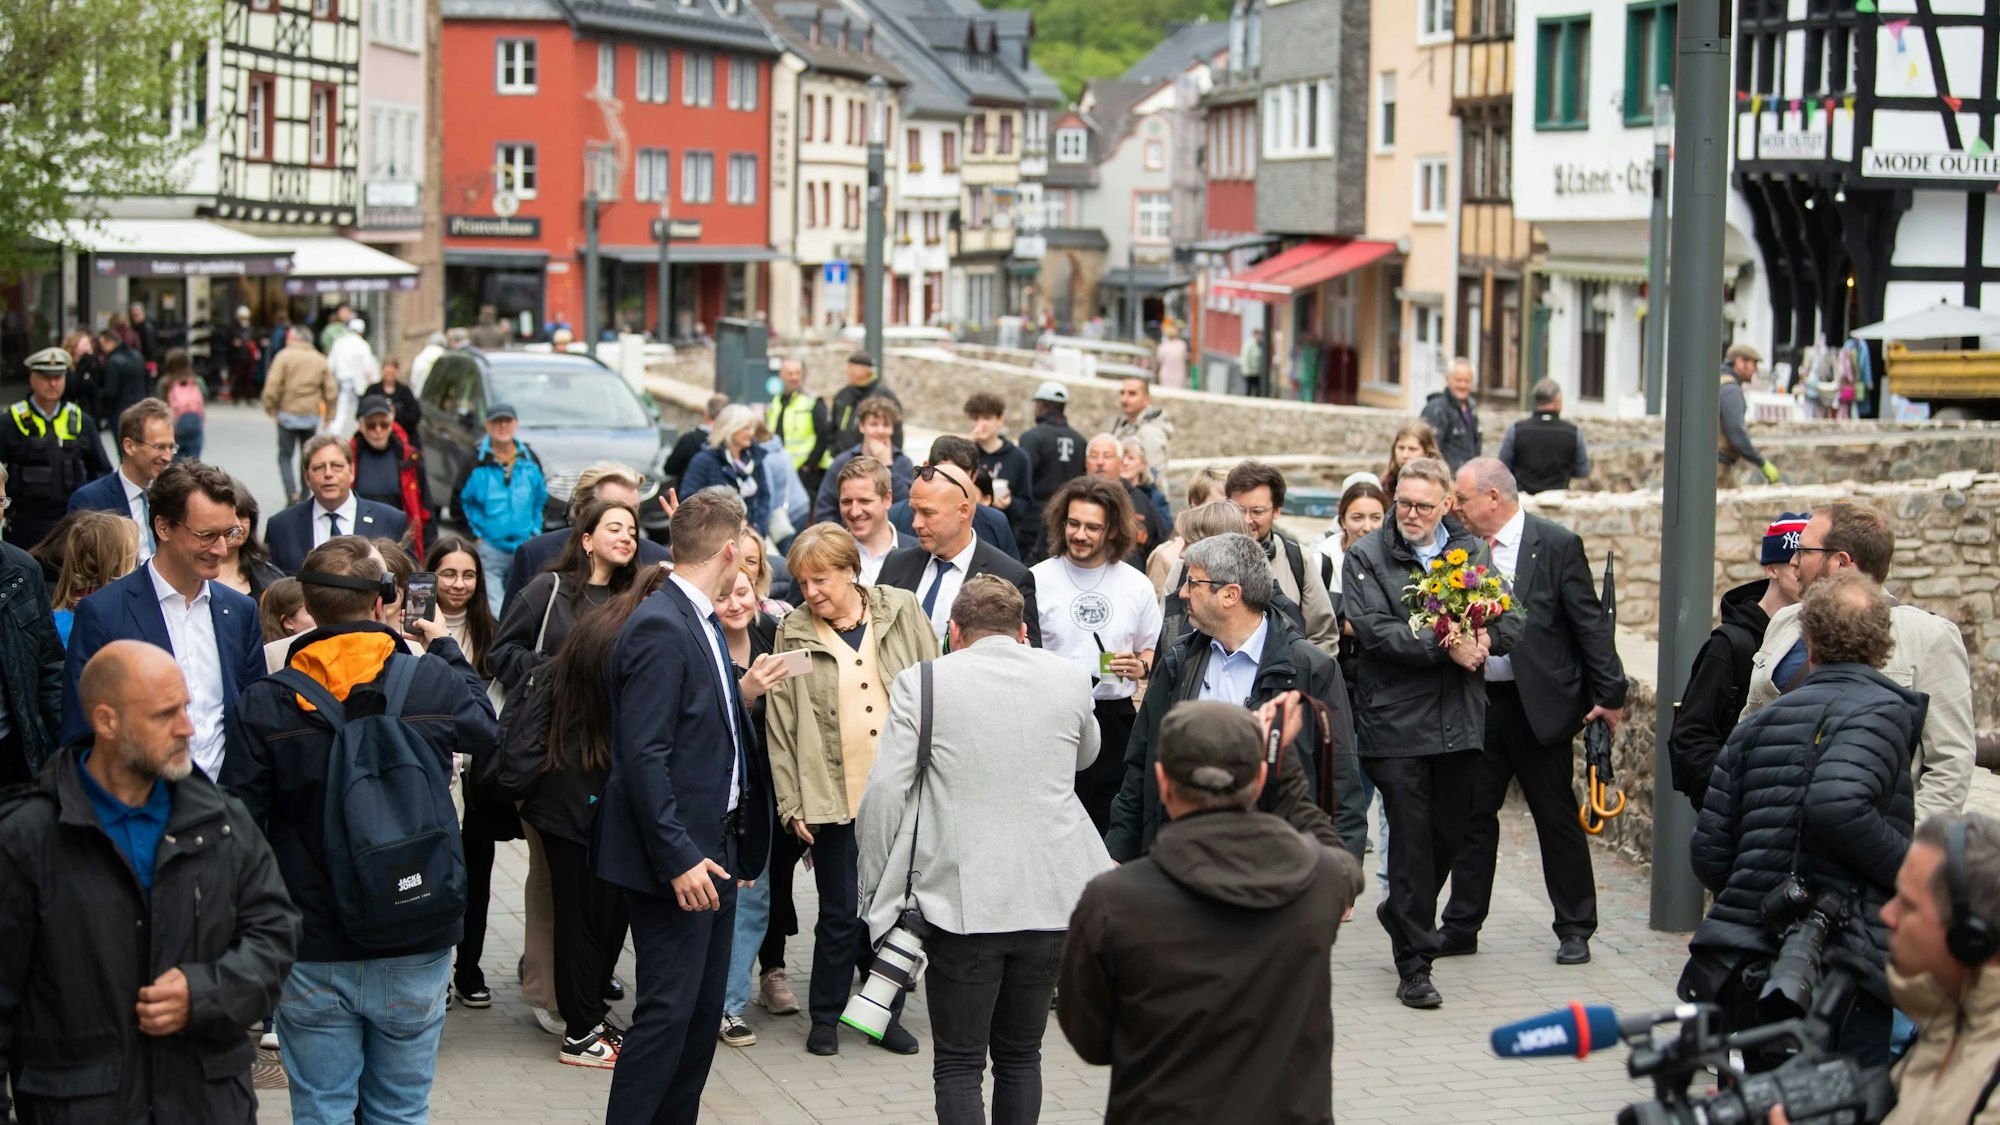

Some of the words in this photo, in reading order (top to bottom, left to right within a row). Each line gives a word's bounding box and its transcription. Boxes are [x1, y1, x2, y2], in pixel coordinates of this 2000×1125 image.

[1872, 153, 1932, 173] MODE
[1057, 437, 1074, 462] T
[1782, 531, 1800, 549] NY
[399, 880, 422, 891] JONES
